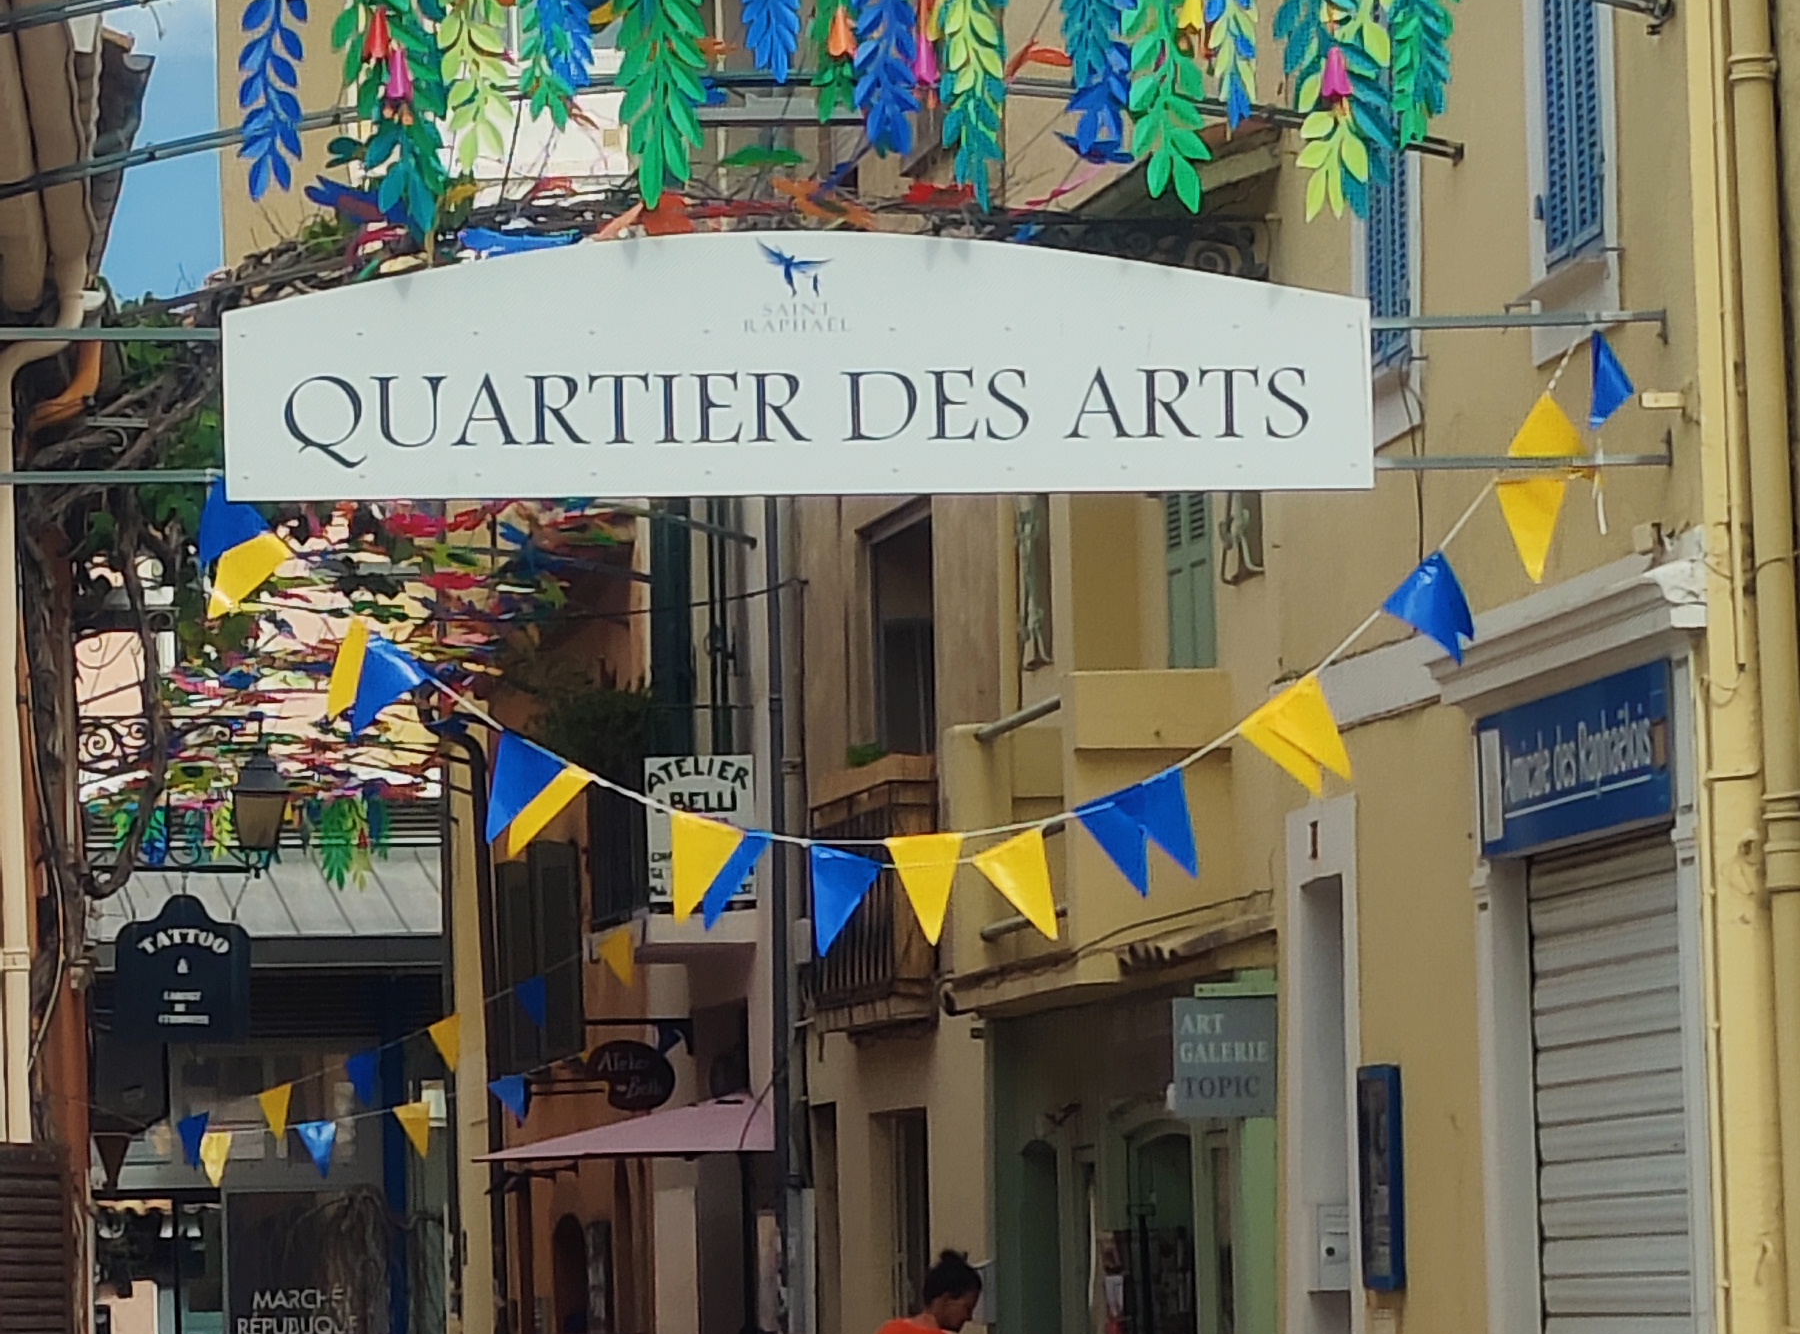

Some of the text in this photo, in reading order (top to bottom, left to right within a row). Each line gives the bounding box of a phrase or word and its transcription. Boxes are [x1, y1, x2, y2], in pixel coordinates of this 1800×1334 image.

[760, 301, 834, 317] SAINT
[283, 366, 1310, 469] QUARTIER DES ARTS
[1504, 700, 1651, 807] Amicale des Raphaëlois
[647, 756, 750, 794] ATELIER
[137, 928, 230, 954] TATTOO
[1181, 1013, 1225, 1035] ART
[1180, 1041, 1269, 1064] GALERIE
[1181, 1075, 1260, 1100] TOPIC
[252, 1282, 345, 1310] MARCHÉ
